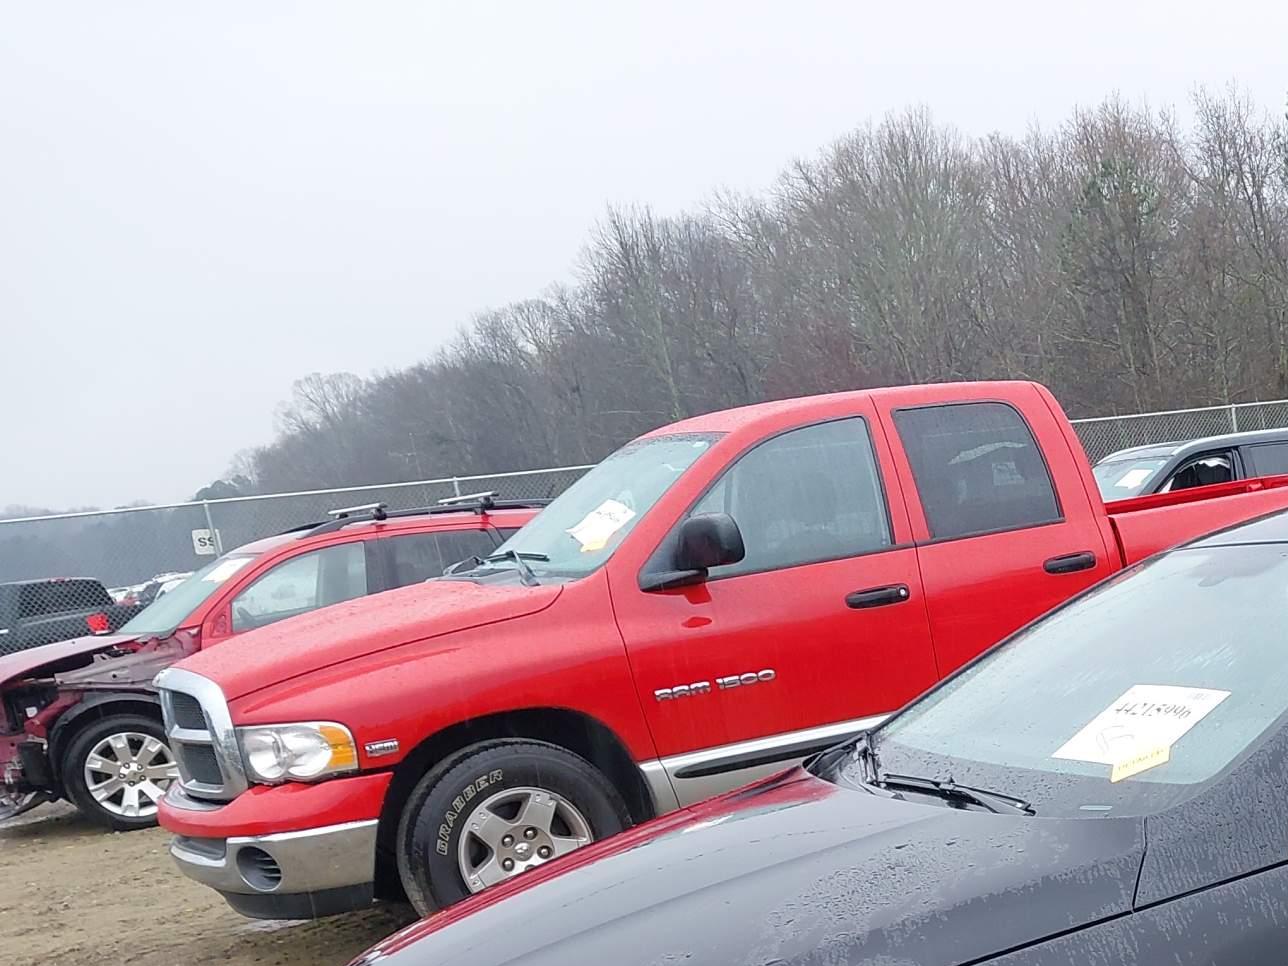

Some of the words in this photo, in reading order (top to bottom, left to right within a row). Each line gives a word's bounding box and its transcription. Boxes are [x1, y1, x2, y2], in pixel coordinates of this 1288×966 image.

[653, 681, 711, 702] RAM
[715, 669, 776, 690] 1500
[436, 769, 504, 856] GRABBER
